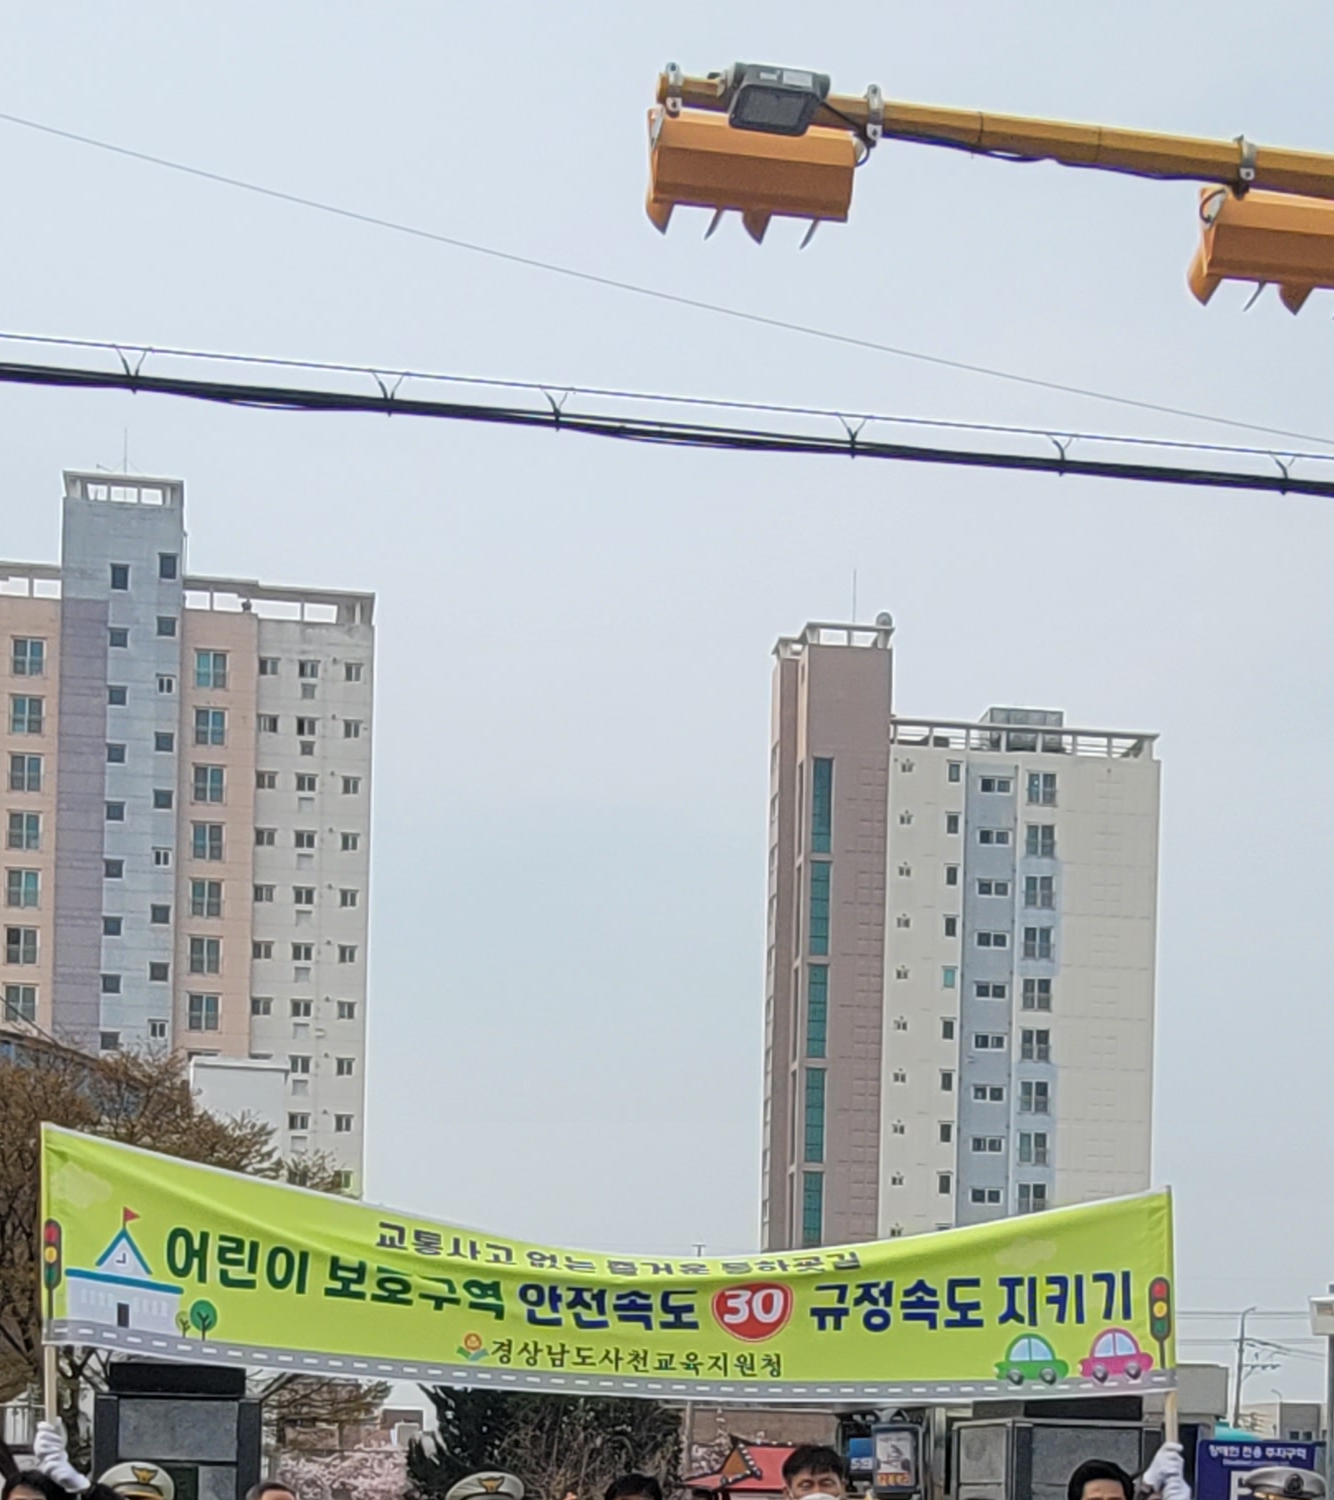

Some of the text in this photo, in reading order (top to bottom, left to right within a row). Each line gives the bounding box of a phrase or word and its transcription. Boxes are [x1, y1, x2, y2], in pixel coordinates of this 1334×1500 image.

[376, 1222, 516, 1264] 교통사고
[525, 1250, 596, 1275] 없는
[165, 1228, 1131, 1332] 어린이 보호구역 안전속도 30 규정속도 지키기
[493, 1339, 780, 1378] 경상남도사천교육지원청
